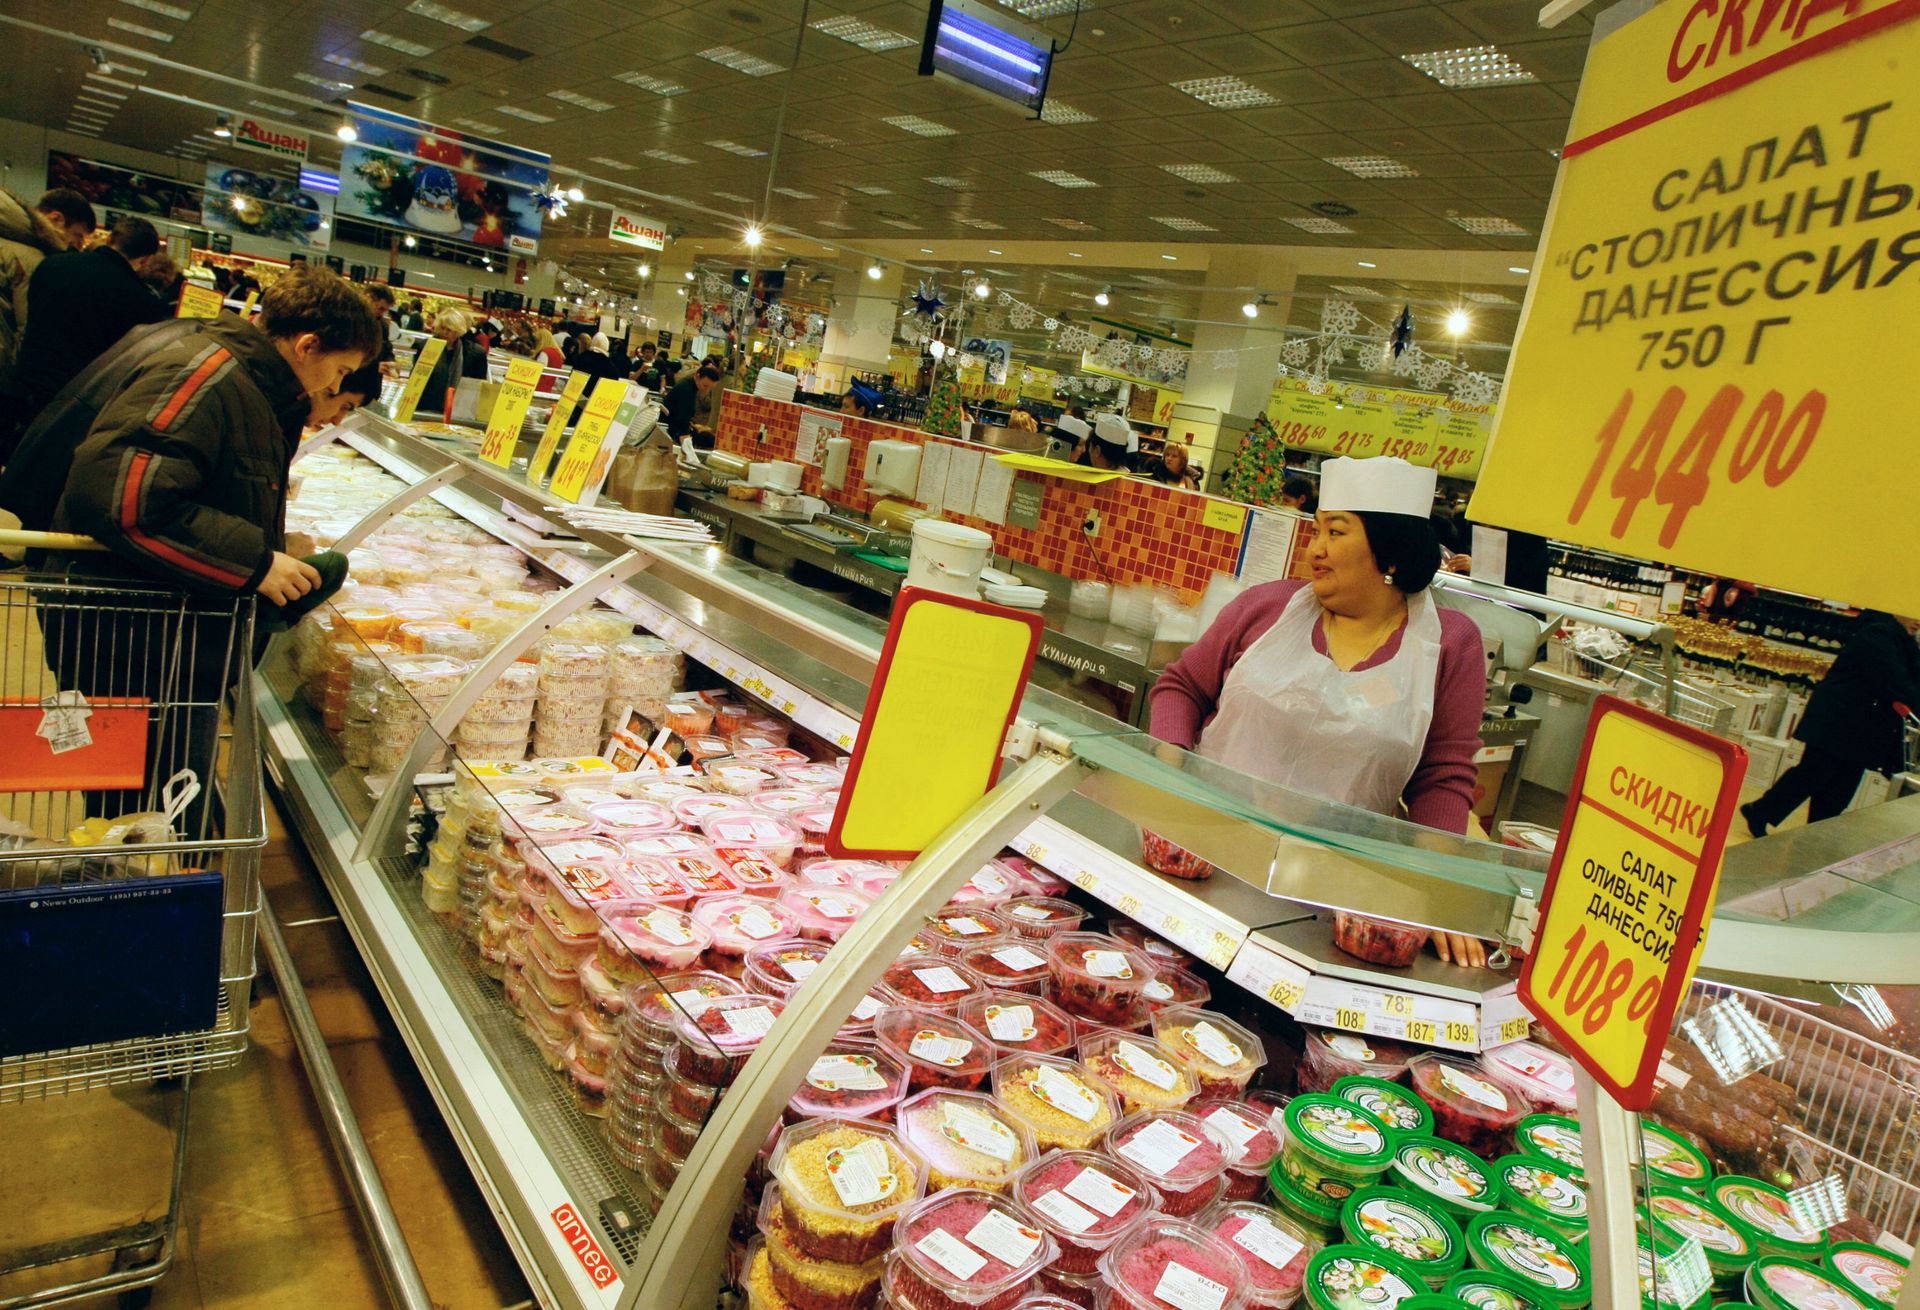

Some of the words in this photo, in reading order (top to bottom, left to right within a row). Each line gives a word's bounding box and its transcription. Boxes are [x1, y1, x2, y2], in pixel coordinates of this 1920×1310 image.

[1666, 0, 1860, 83] СК
[237, 119, 307, 151] Ашан
[1652, 101, 1893, 212] САЛАТ
[613, 215, 664, 241] Ашан
[1636, 325, 1726, 373] 750
[1744, 316, 1791, 366] Г
[1041, 643, 1106, 675] КУЛИНАРИЯ
[1609, 765, 1712, 840] СКИДКИ
[1581, 857, 1649, 915] ОЛИВЬЕ
[1620, 850, 1678, 899] САЛАТ
[68, 895, 105, 905] Outdoor
[1585, 892, 1676, 965] ДАНЕССИЯ
[1335, 1009, 1359, 1029] 108
[1384, 993, 1405, 1013] 78
[1406, 1021, 1430, 1041] 187
[1446, 1021, 1469, 1042] 139
